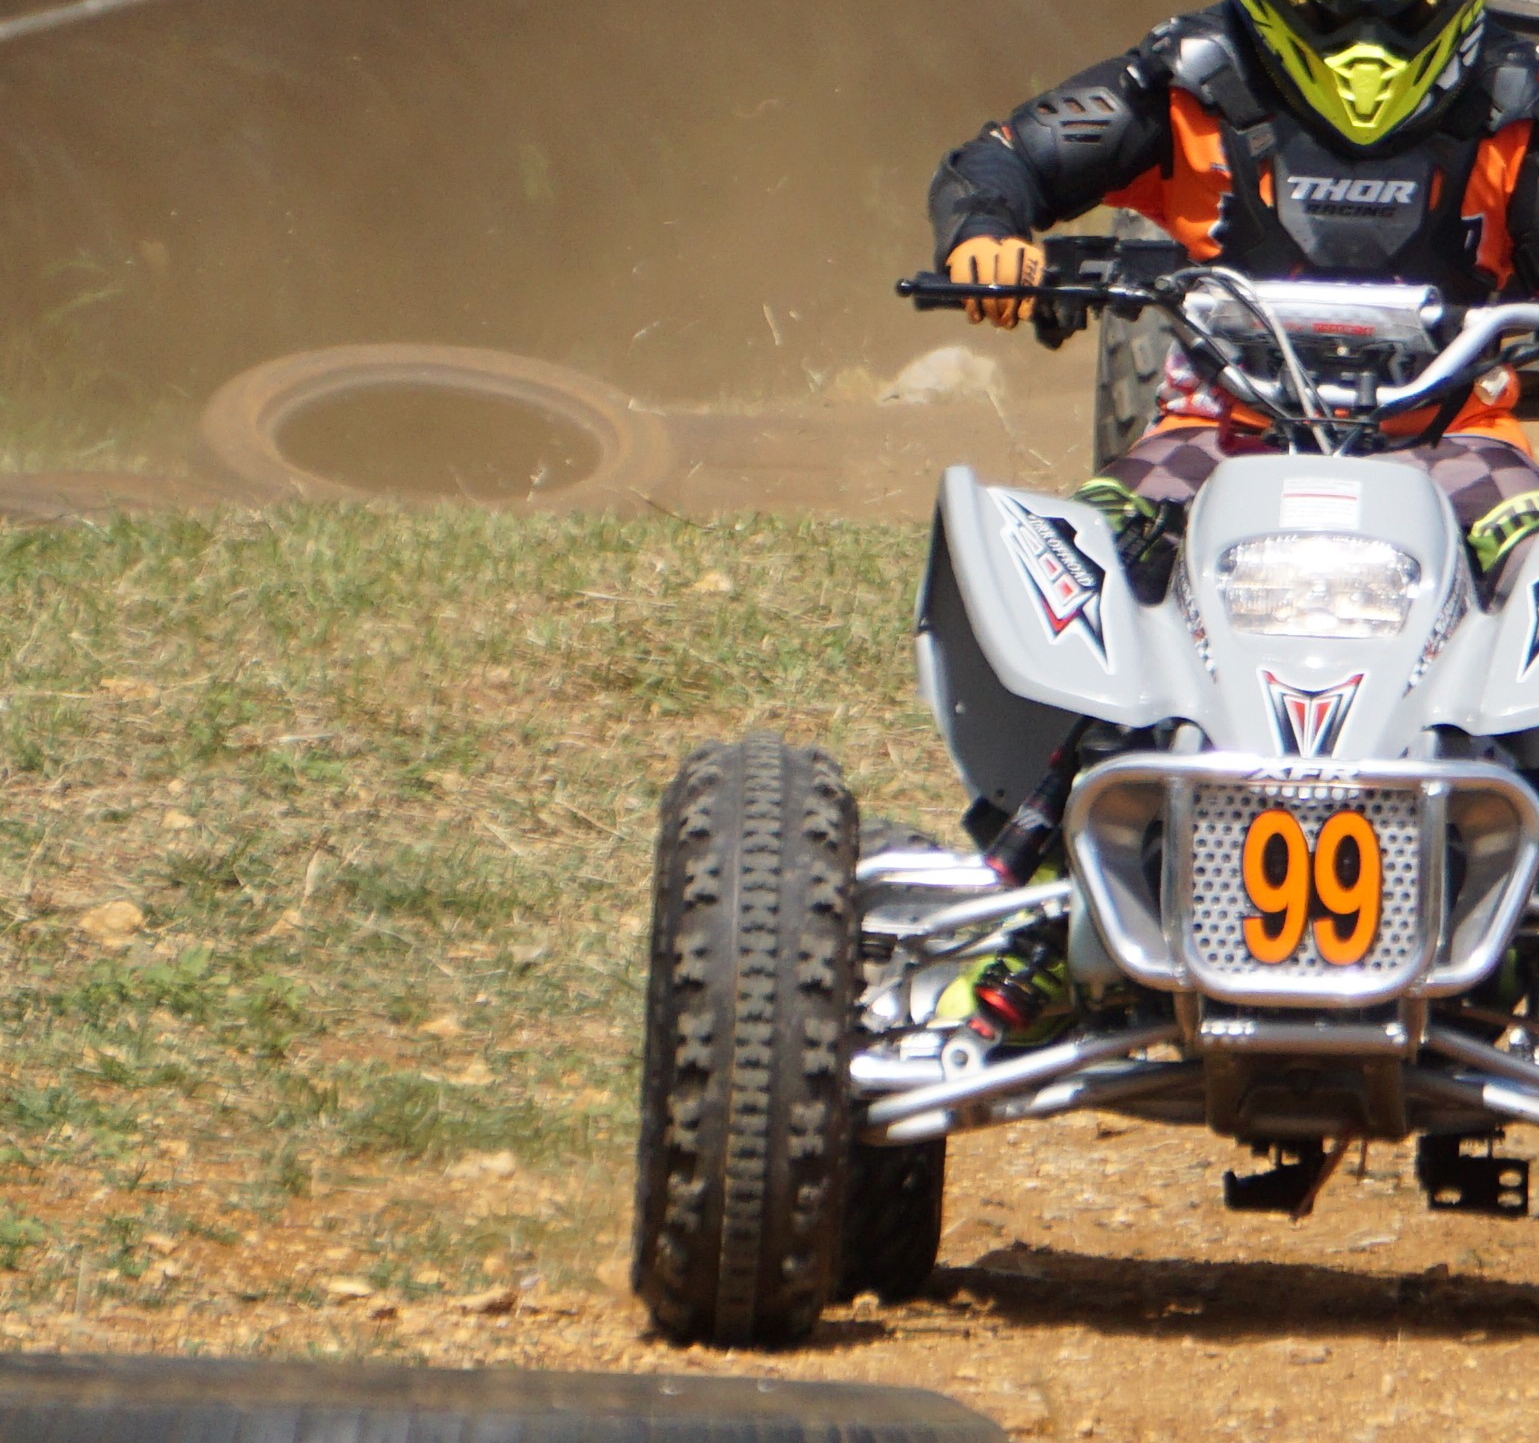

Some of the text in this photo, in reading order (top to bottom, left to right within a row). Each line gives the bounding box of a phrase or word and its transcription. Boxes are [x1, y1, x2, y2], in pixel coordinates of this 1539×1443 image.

[1286, 175, 1419, 206] THOR
[1304, 203, 1400, 218] RACING
[1241, 763, 1360, 781] XFR
[1242, 809, 1383, 966] 99
